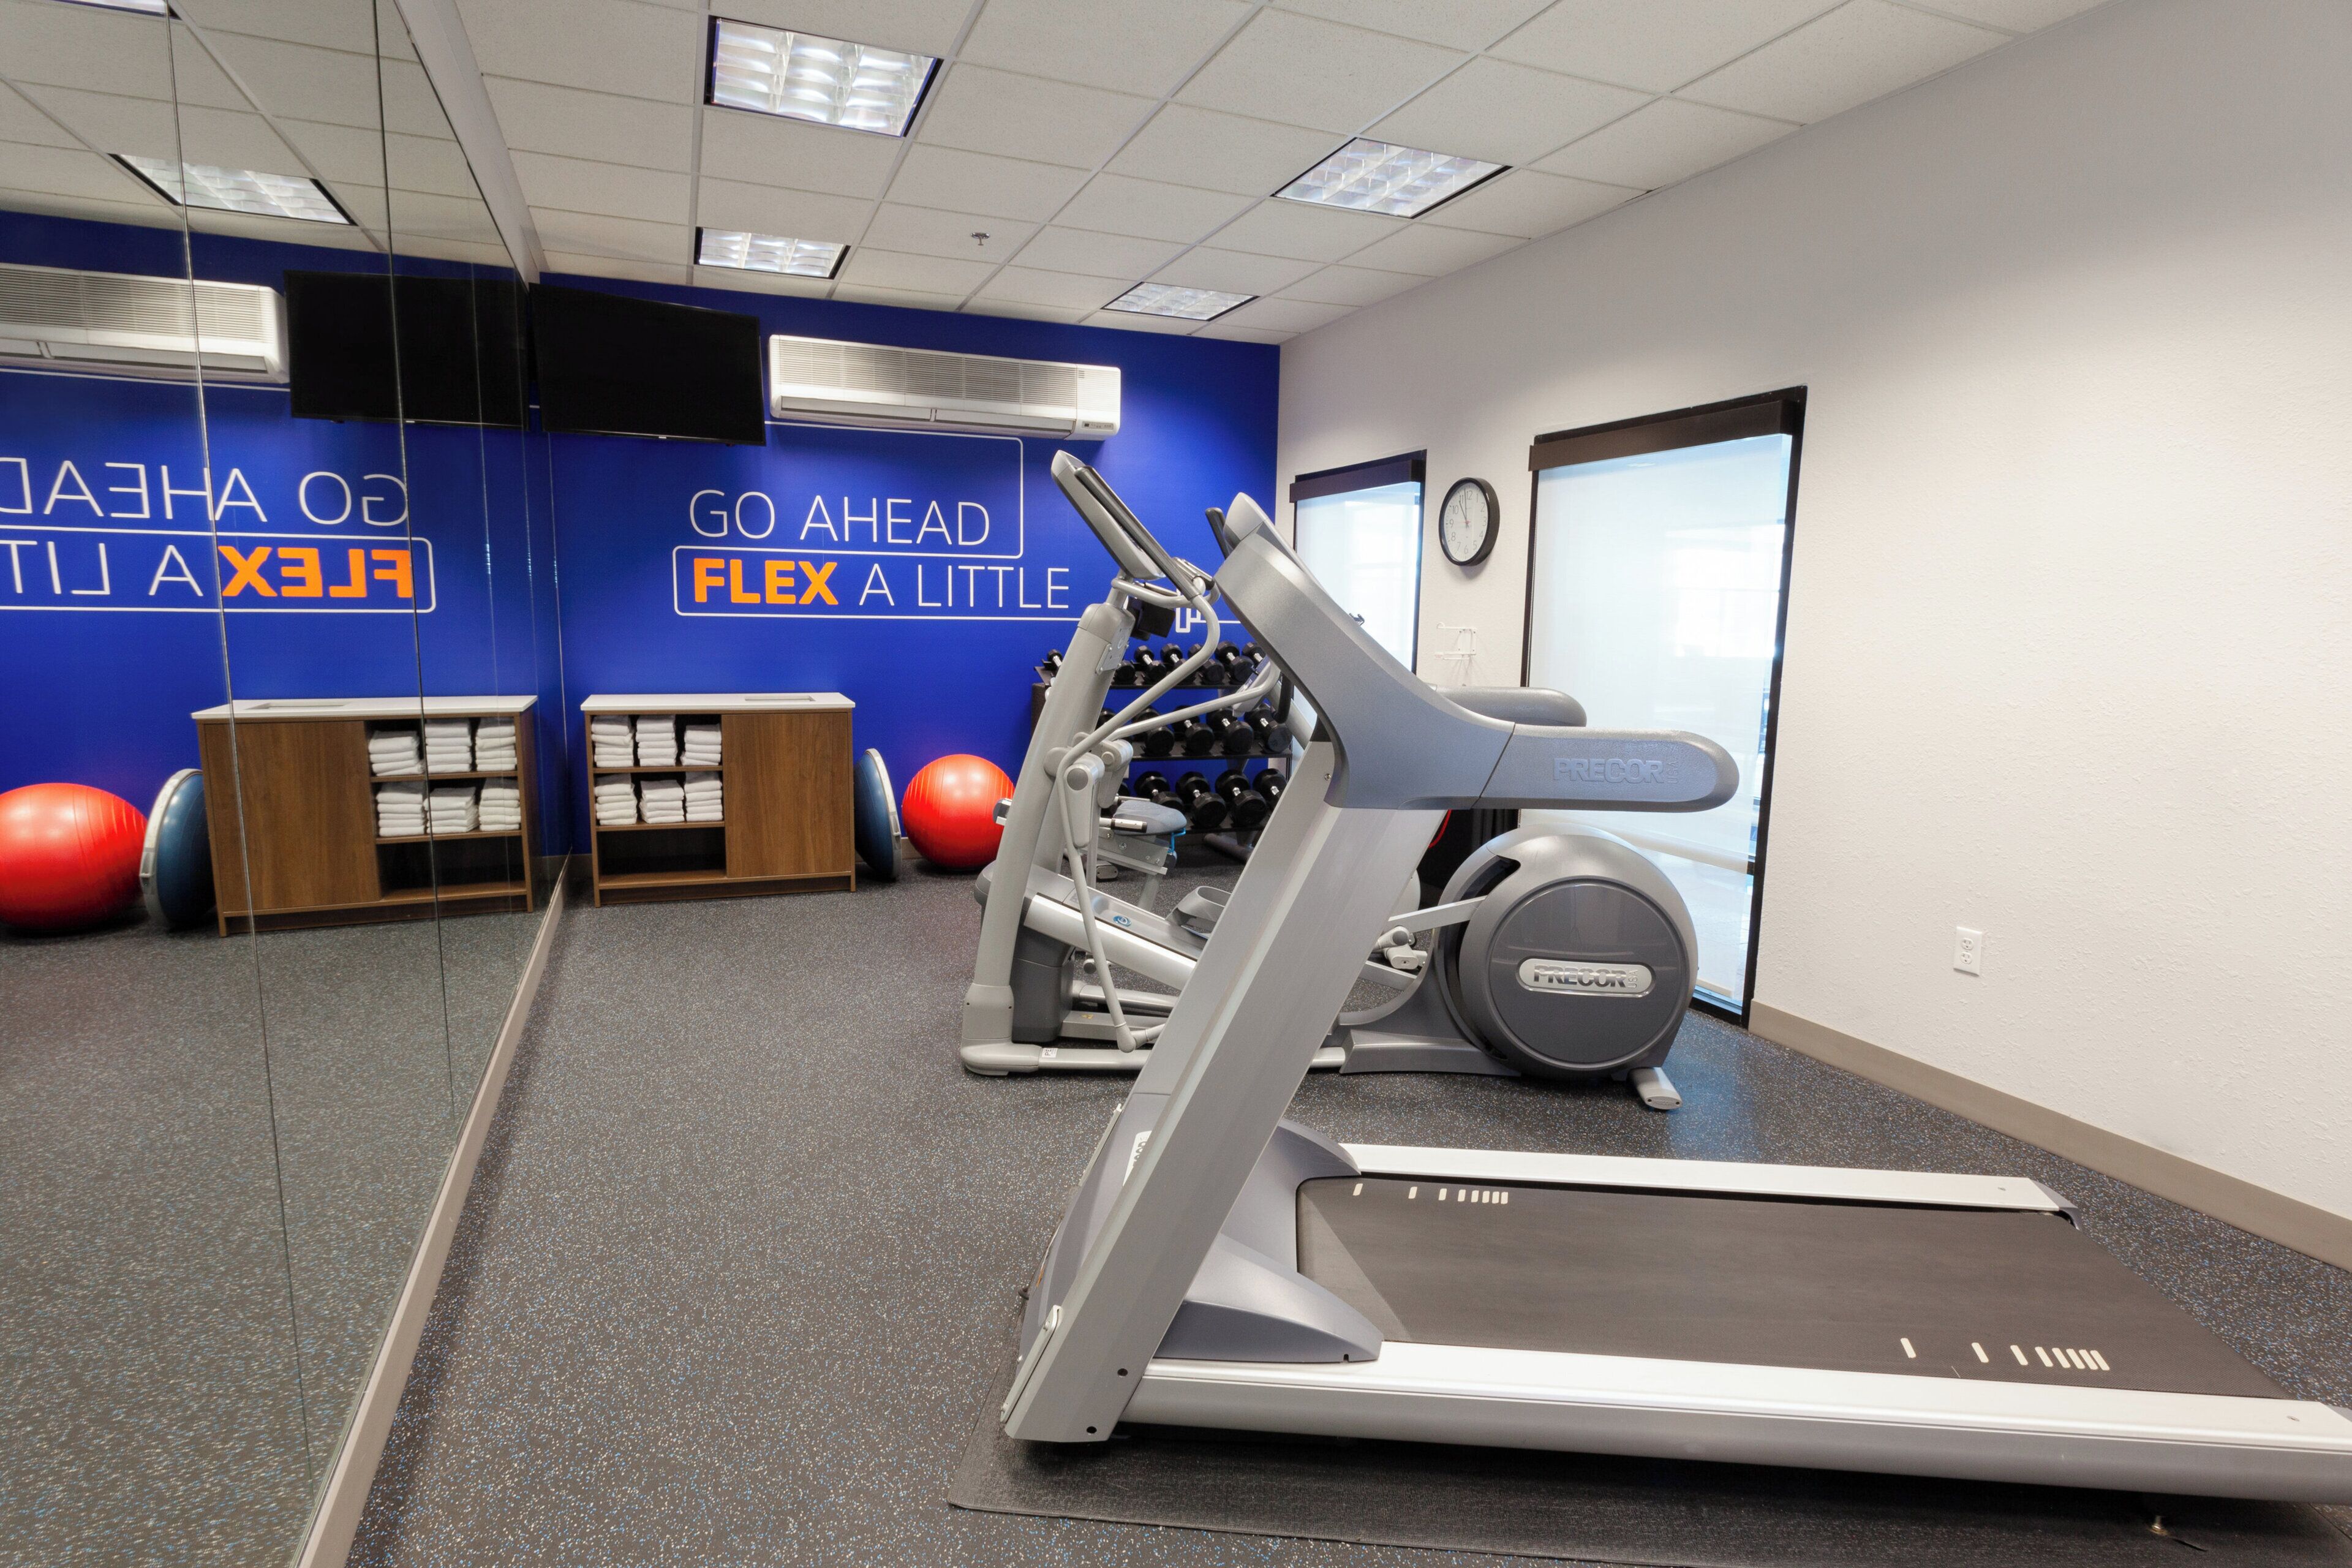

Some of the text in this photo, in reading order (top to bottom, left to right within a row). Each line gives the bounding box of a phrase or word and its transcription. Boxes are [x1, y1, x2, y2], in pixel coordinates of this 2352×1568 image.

[1466, 490, 1473, 500] 12
[1452, 505, 1458, 514] 10
[1480, 502, 1485, 512] 2
[690, 489, 990, 546] GO AHEAD
[1482, 516, 1487, 526] 3
[1450, 519, 1454, 527] 9
[1451, 532, 1456, 541] 8
[1479, 530, 1483, 540] 4
[1457, 542, 1461, 551] 7
[1464, 545, 1469, 554] 6
[1472, 540, 1477, 549] 5
[693, 558, 1069, 609] FLEX A LITTLE
[1553, 758, 1664, 783] PRECOR
[1534, 964, 1638, 988] PRECOR USA
